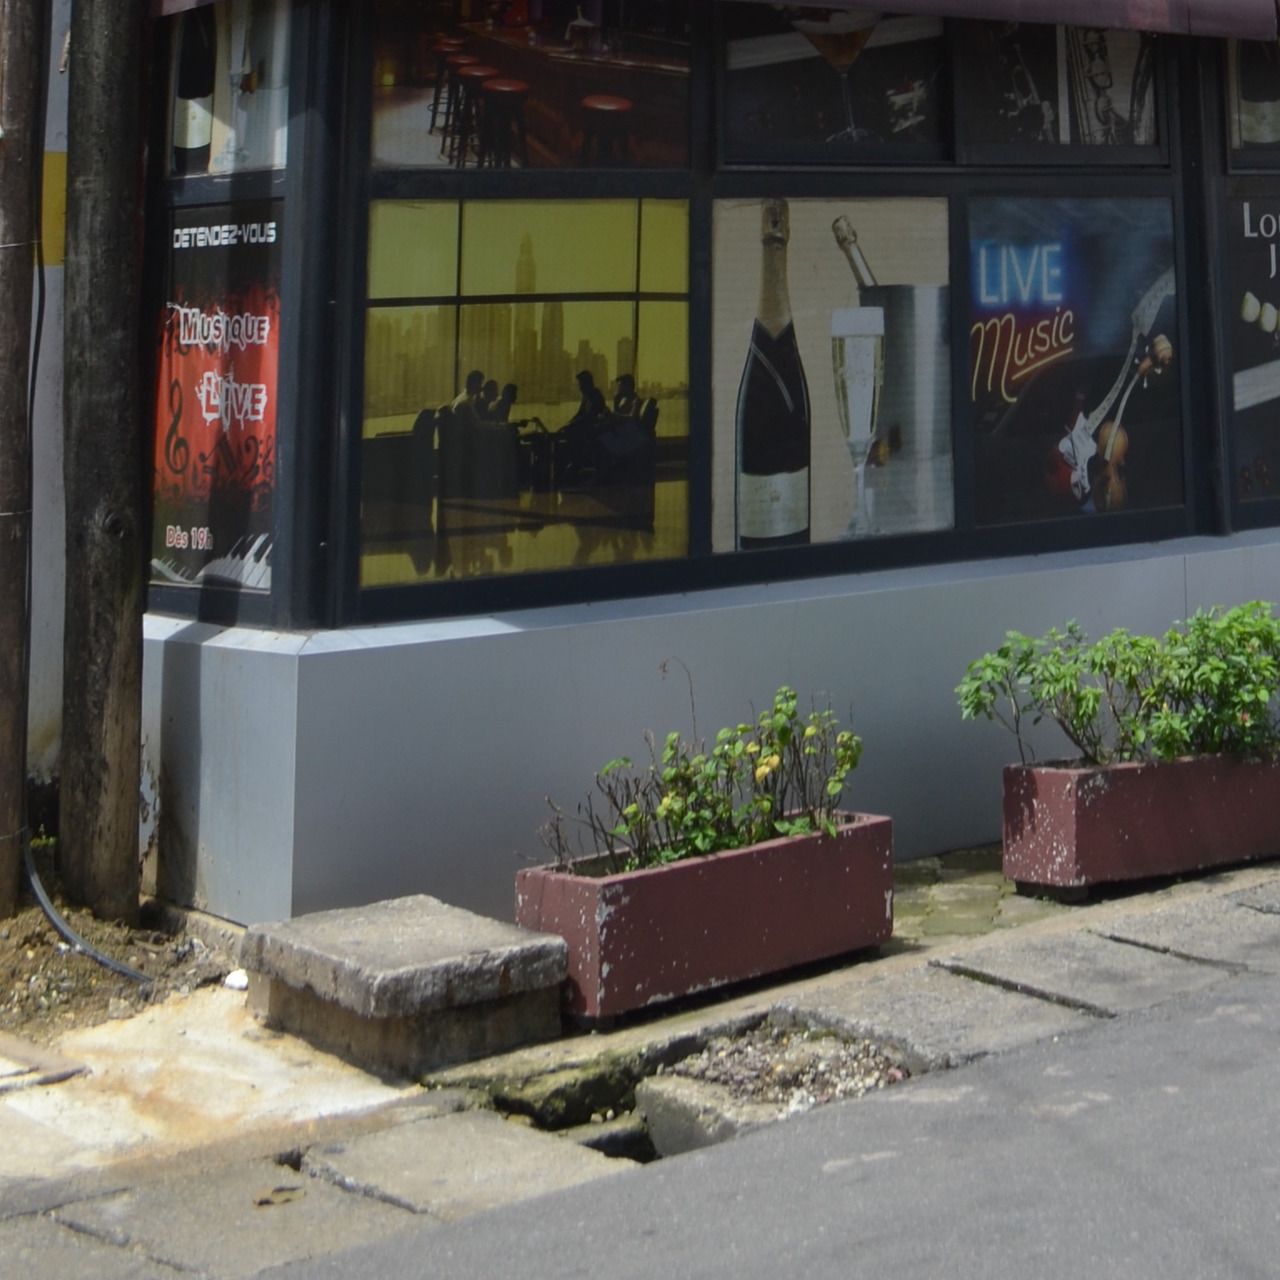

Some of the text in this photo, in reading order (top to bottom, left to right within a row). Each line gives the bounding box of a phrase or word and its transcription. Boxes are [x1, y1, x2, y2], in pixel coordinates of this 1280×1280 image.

[979, 243, 1063, 304] LIVE
[179, 307, 269, 347] MUSIQUE
[201, 372, 268, 424] LIVE
[166, 525, 213, 550] Dès 19h
